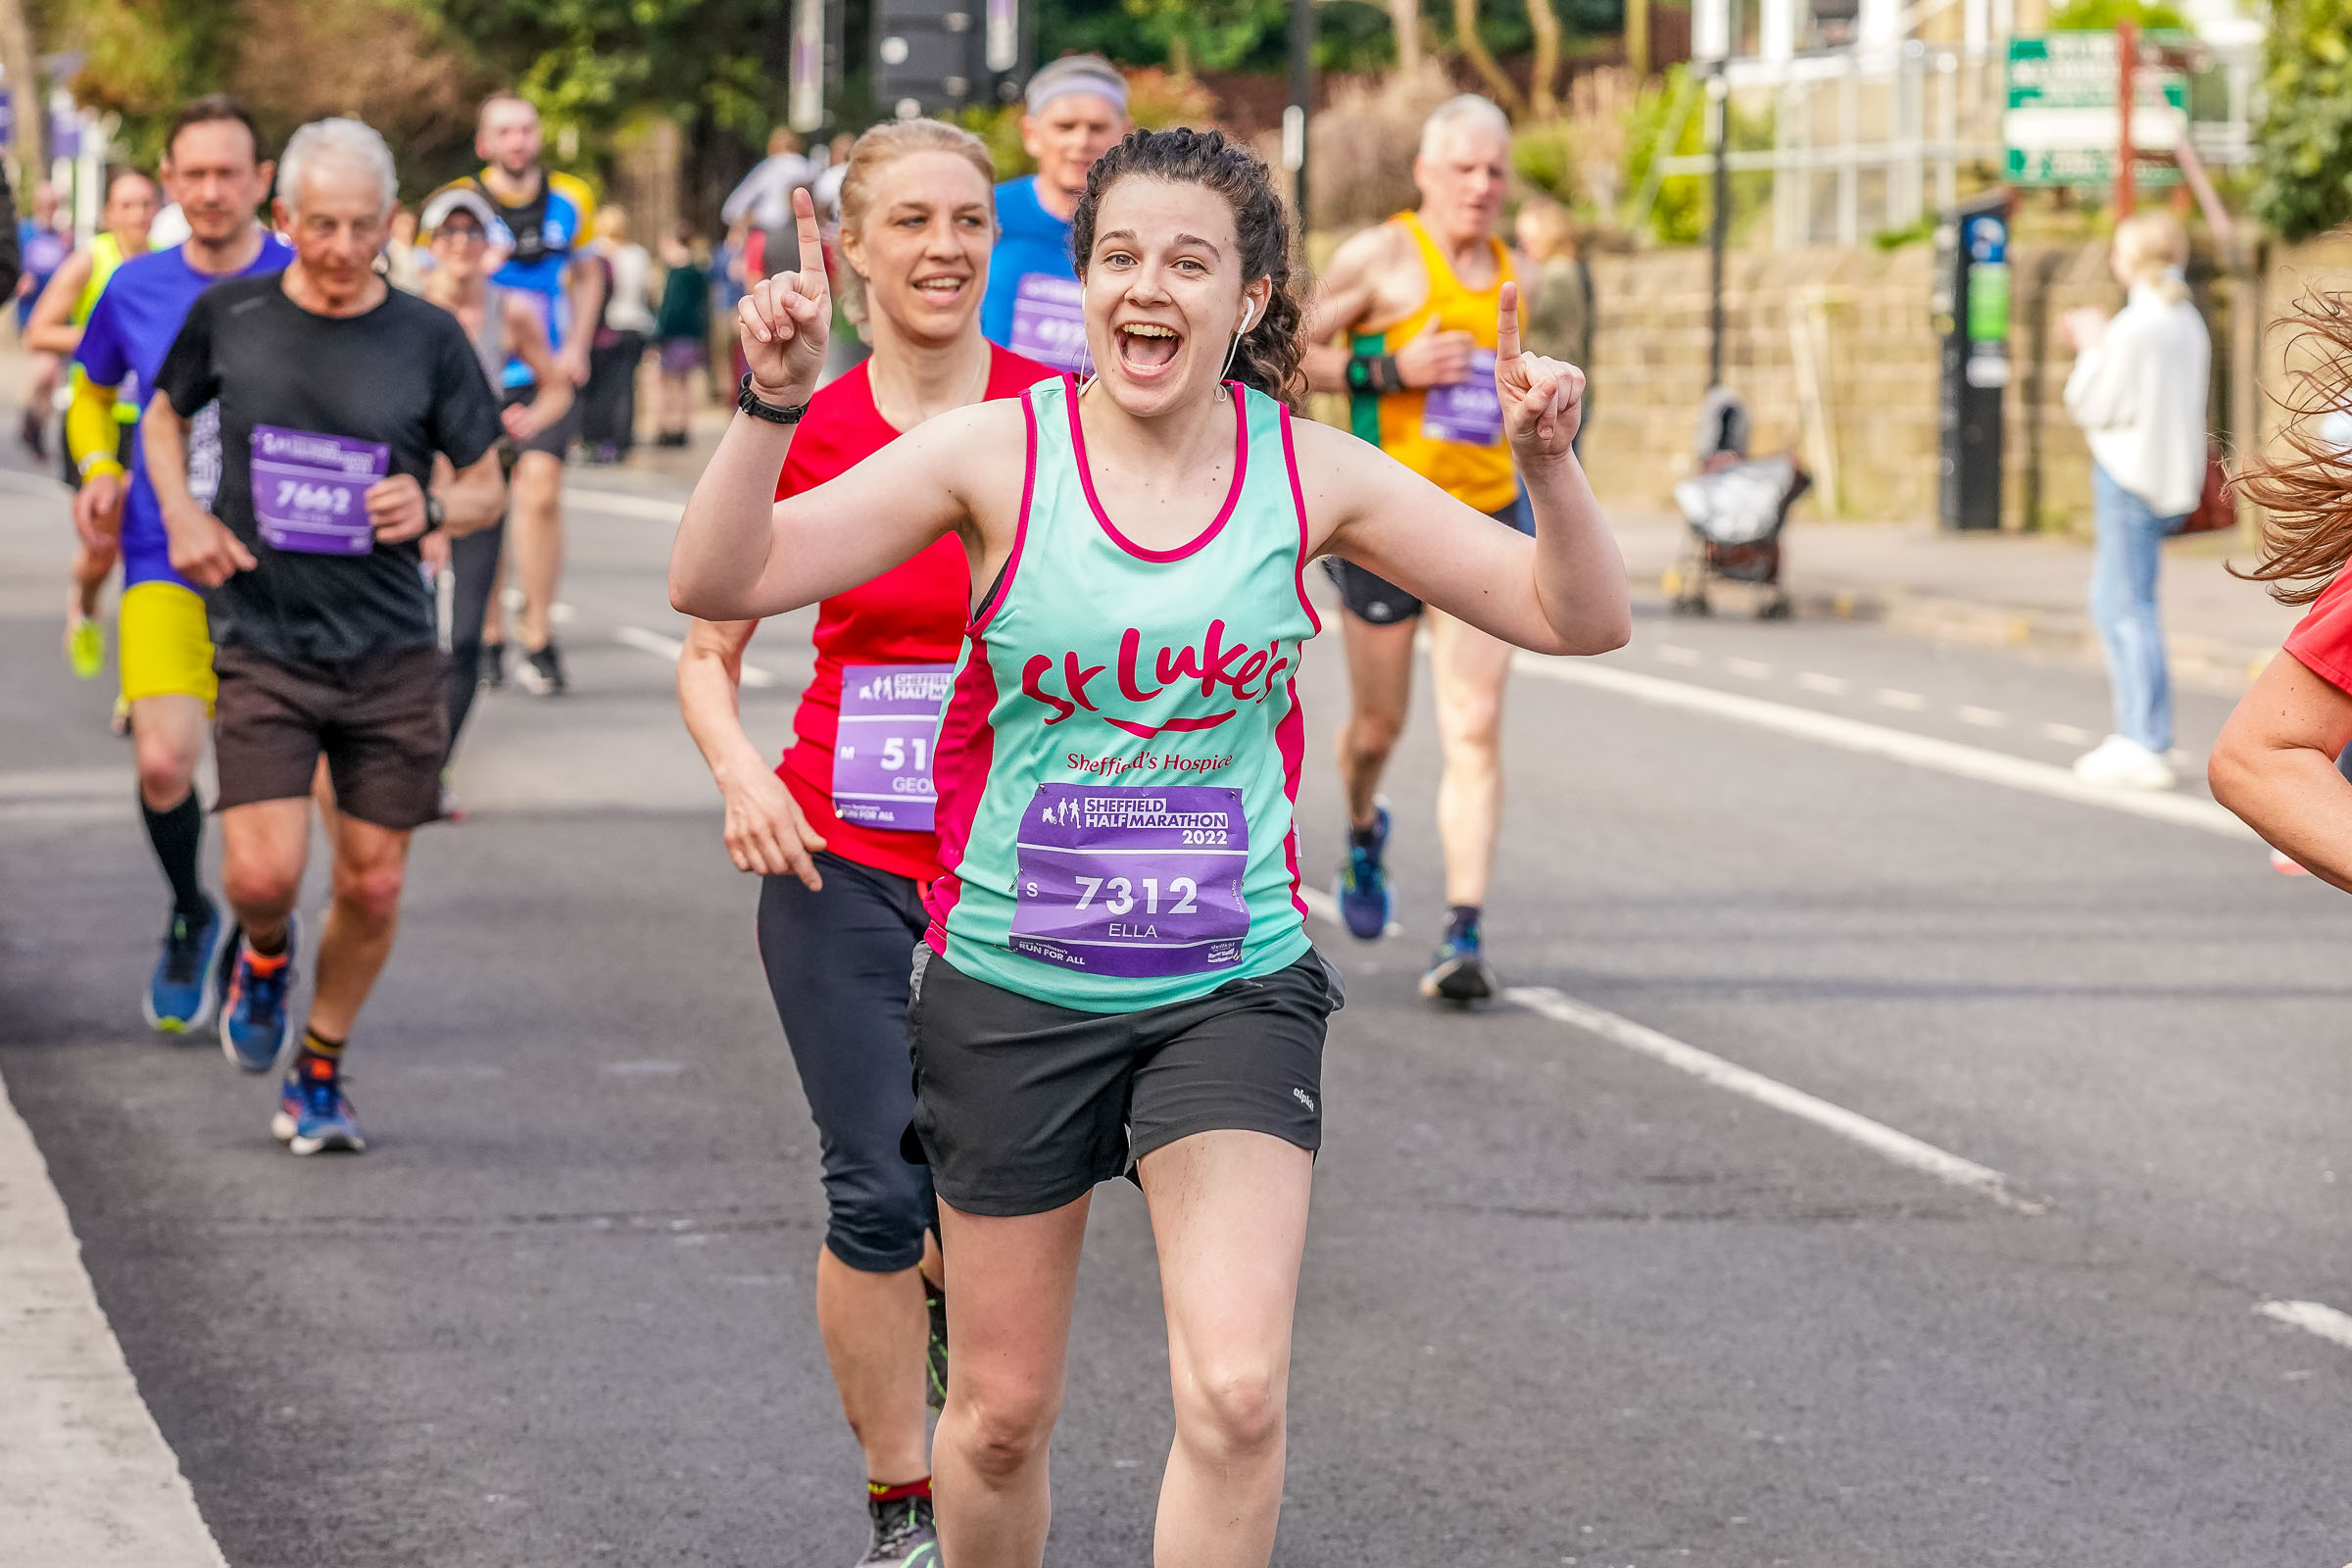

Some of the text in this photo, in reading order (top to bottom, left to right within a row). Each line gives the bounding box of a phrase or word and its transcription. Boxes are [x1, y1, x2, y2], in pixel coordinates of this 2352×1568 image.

[898, 673, 952, 685] SHEFFIEL
[1022, 618, 1288, 725] St Luke's
[840, 746, 855, 760] M
[1163, 754, 1233, 773] Hospice
[892, 776, 935, 793] GEO
[1086, 799, 1164, 812] SHEFFIELD
[1085, 814, 1227, 828] HALF MARATHON
[1182, 830, 1228, 845] 2022
[1026, 882, 1039, 897] S
[1074, 875, 1198, 915] 7312
[1108, 923, 1158, 939] ELLA
[1019, 943, 1086, 965] RUN FOR ALL
